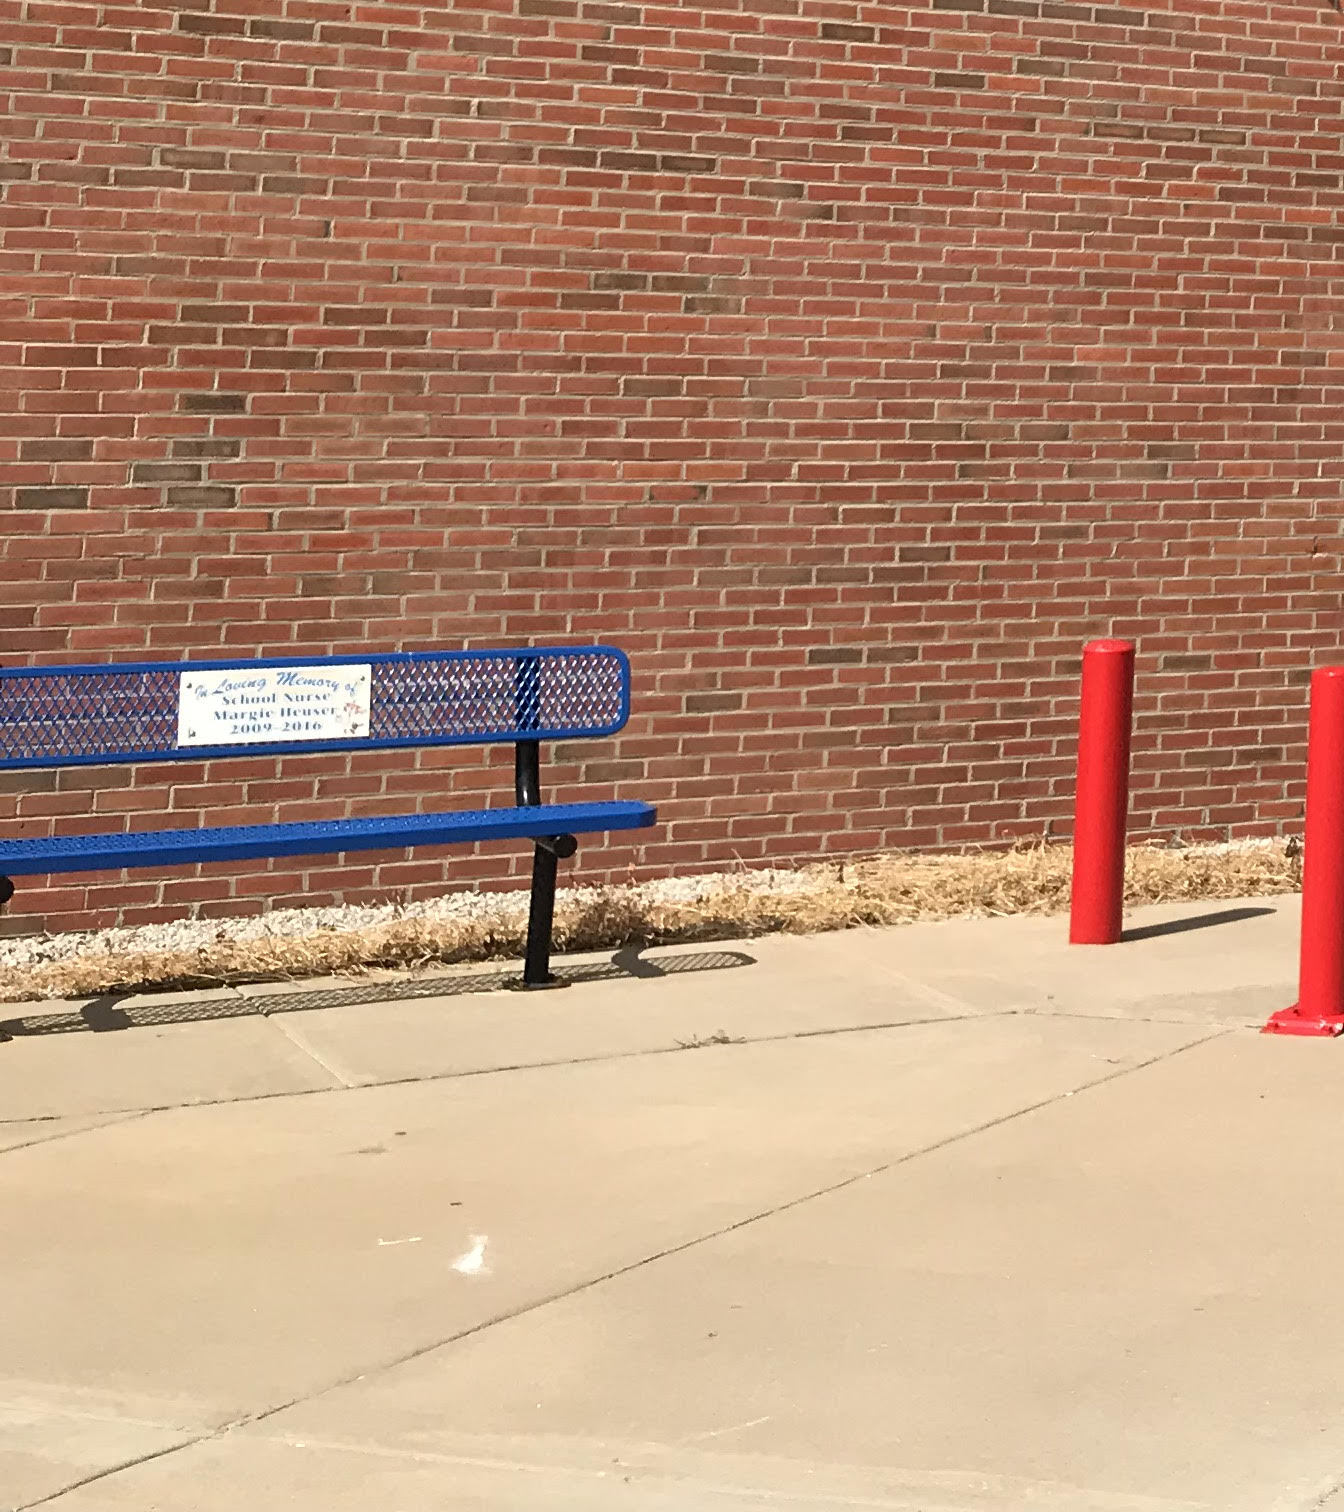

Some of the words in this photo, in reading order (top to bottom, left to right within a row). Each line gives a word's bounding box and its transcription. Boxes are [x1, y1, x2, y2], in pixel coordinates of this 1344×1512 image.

[194, 684, 208, 699] In
[212, 675, 267, 694] Loving
[276, 671, 340, 690] Memory
[344, 679, 358, 697] of
[222, 693, 276, 705] School
[284, 691, 333, 703] Nurse
[213, 708, 274, 721] Margie
